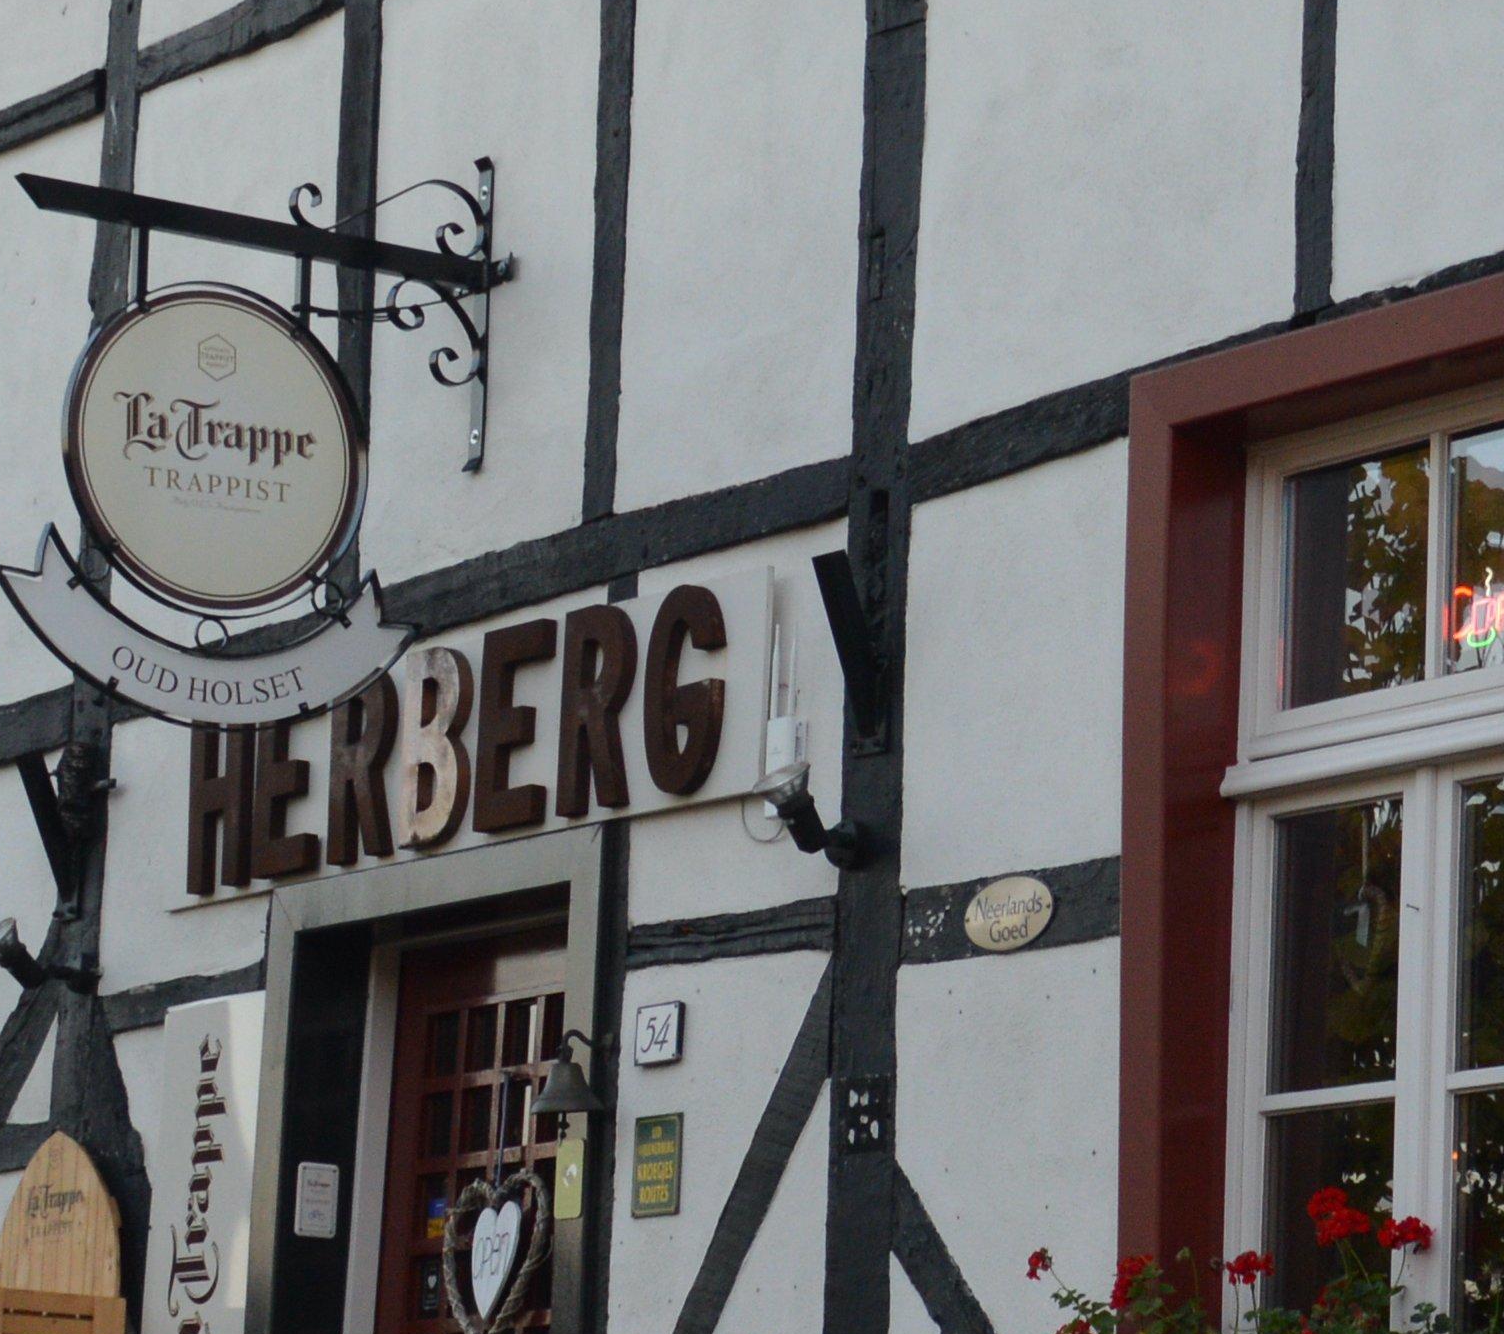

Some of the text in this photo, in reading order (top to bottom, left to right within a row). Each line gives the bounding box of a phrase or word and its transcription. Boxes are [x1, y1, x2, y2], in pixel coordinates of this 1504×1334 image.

[113, 391, 317, 469] La Trappe
[143, 466, 291, 503] TRAPPIST
[111, 645, 306, 706] OUD HOLSET
[186, 584, 728, 896] HERBERG
[974, 890, 1043, 921] Neerlands
[988, 917, 1029, 943] Goed
[640, 1013, 672, 1054] 54
[167, 1033, 228, 1317] Trappe
